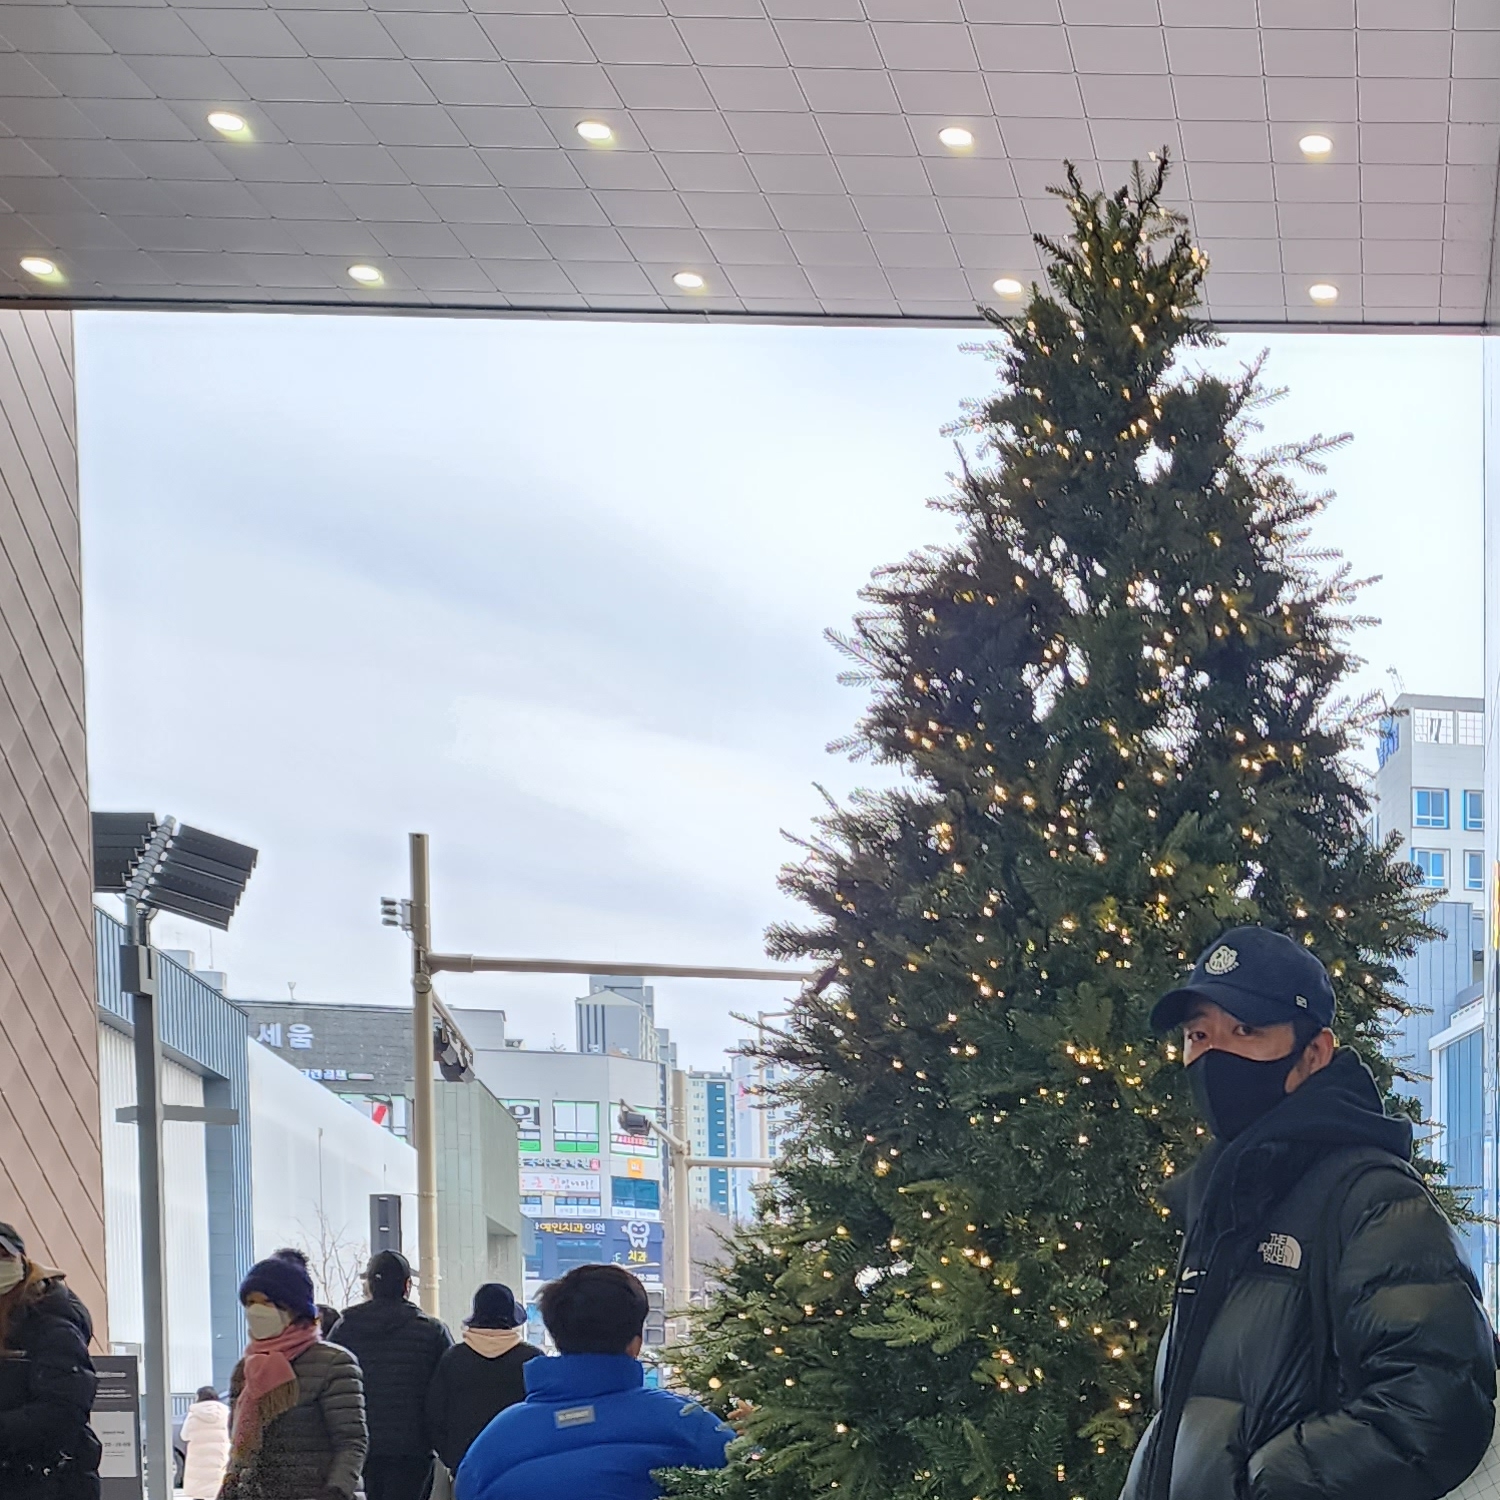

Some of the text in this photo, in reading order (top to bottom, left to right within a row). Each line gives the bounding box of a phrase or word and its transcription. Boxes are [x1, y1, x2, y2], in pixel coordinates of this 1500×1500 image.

[257, 1022, 313, 1049] 세움
[1270, 1232, 1288, 1245] THE
[628, 1250, 647, 1263] 치과
